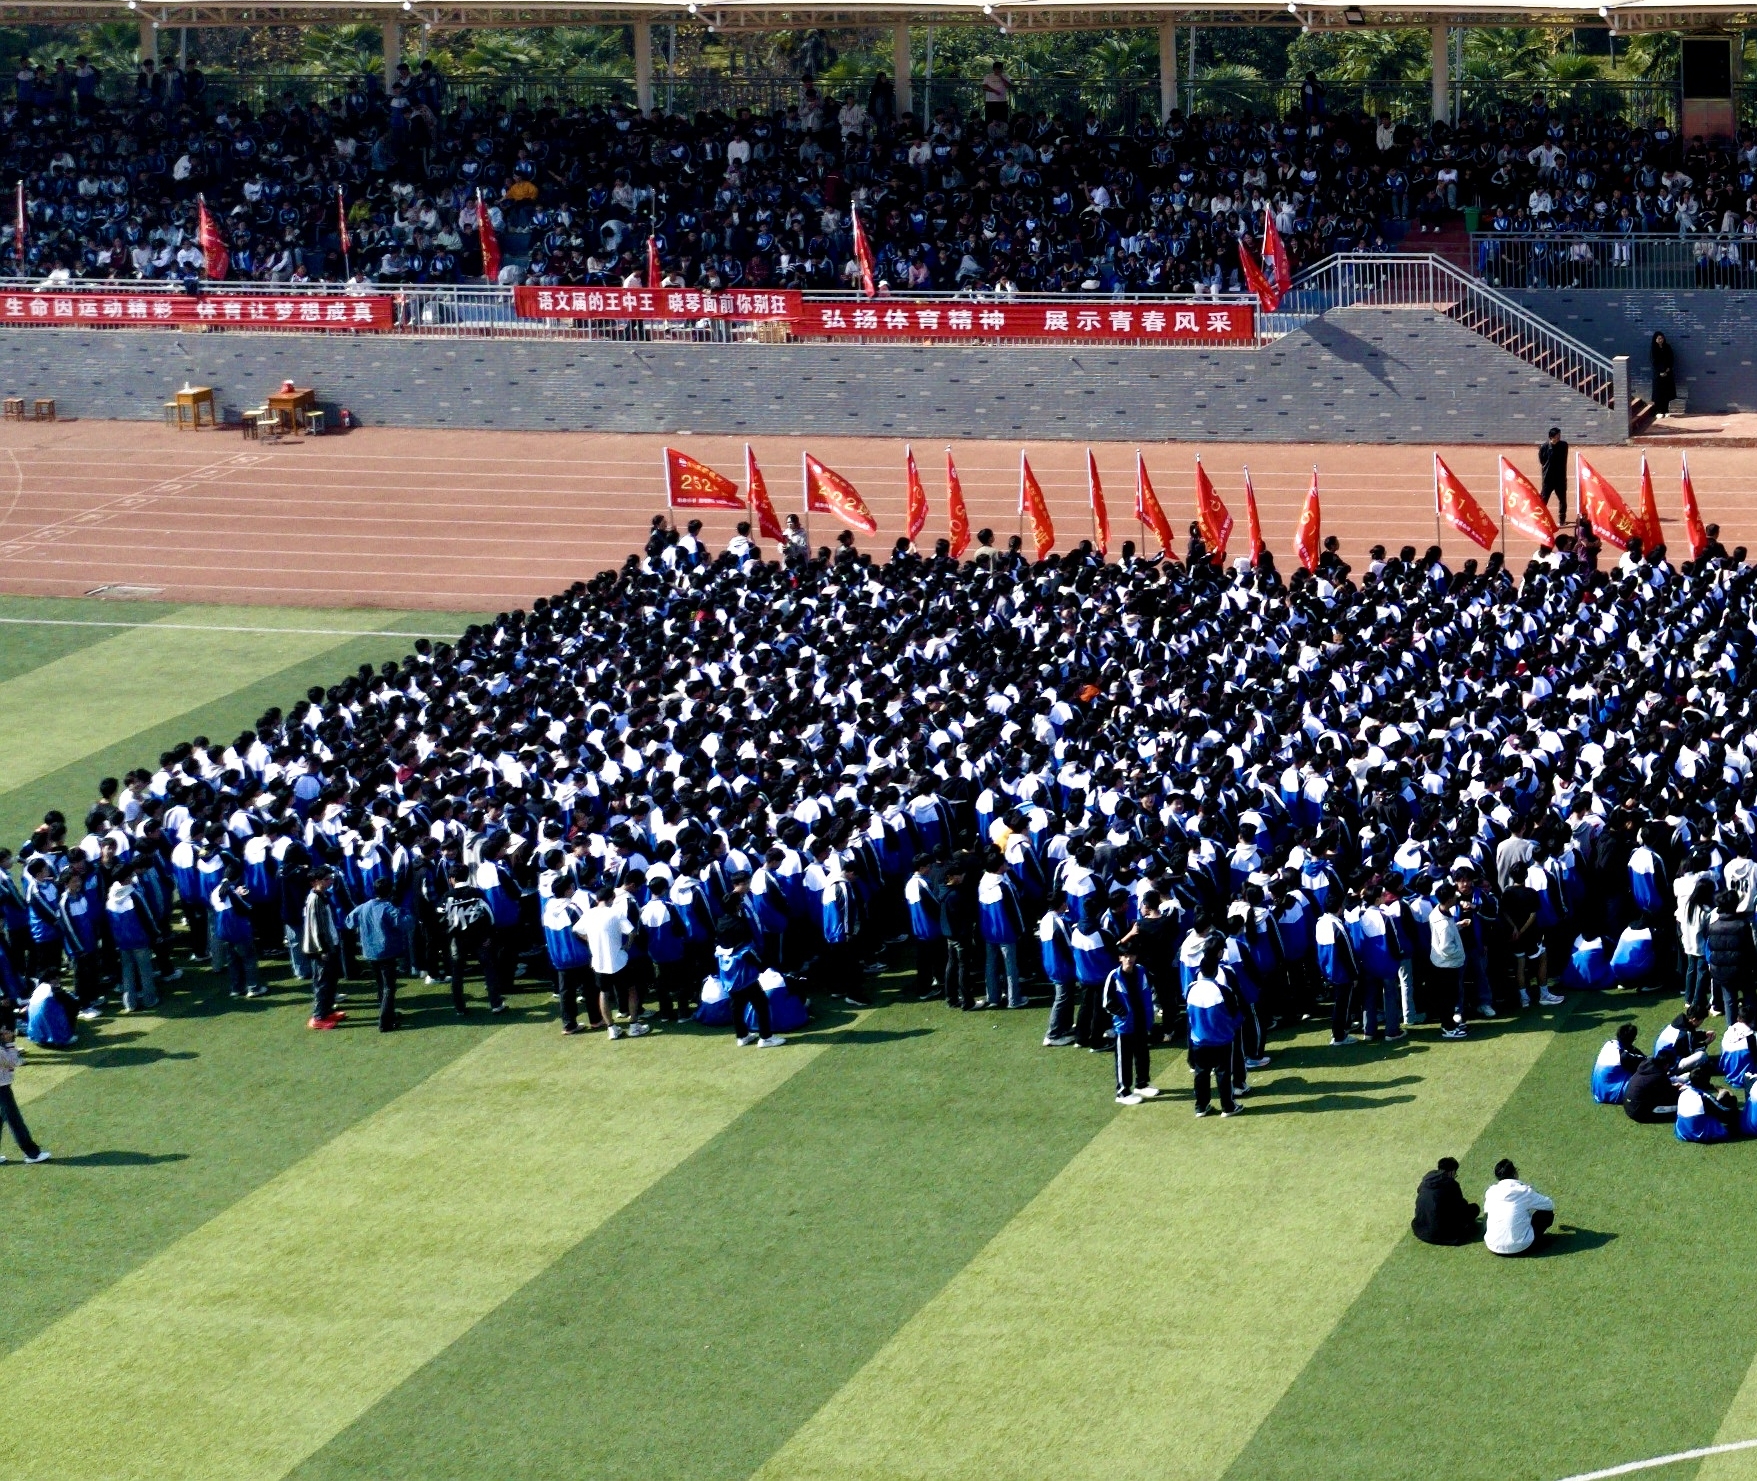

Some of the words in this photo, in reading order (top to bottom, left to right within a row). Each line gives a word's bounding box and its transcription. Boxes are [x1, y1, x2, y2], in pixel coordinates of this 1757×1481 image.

[5, 297, 174, 319] 生命因运动精彩
[196, 299, 374, 323] 体育让梦想成真
[668, 293, 788, 316] 晓琴面前你别狂
[821, 308, 1006, 331] 弘扬体育精神
[1043, 310, 1233, 334] 展示青春风采
